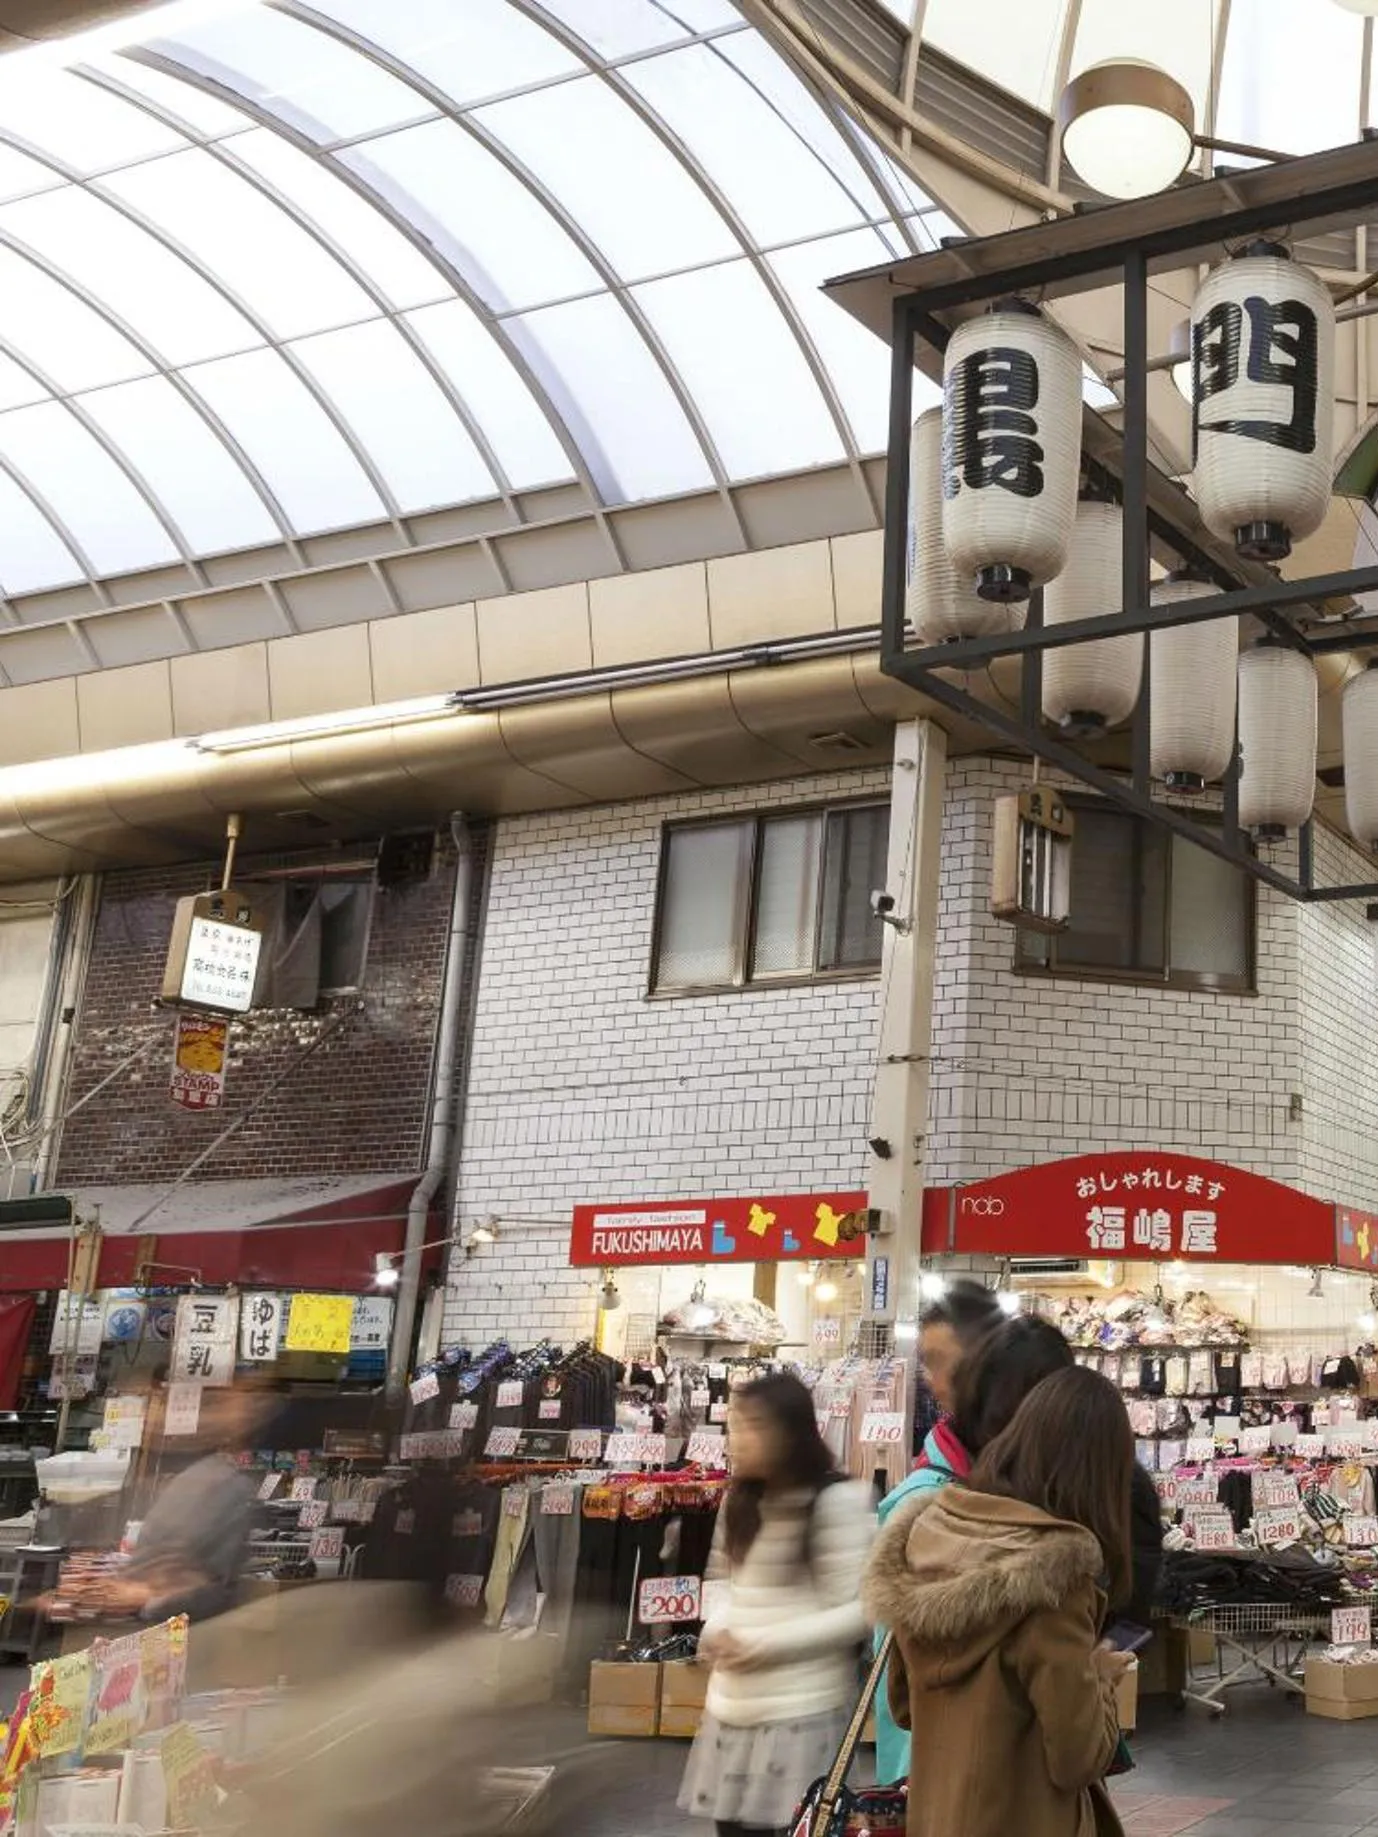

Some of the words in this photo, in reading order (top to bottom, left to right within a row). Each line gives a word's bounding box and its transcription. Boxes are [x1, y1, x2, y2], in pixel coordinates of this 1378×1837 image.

[1076, 1167, 1226, 1201] おしゃれします
[592, 1227, 703, 1255] FUKUSHIMAYA
[1085, 1205, 1218, 1252] 福嶋屋
[187, 1304, 218, 1377] 豆乳
[249, 1298, 275, 1357] ゆば
[1263, 1522, 1296, 1540] 1280
[651, 1594, 695, 1618] 200
